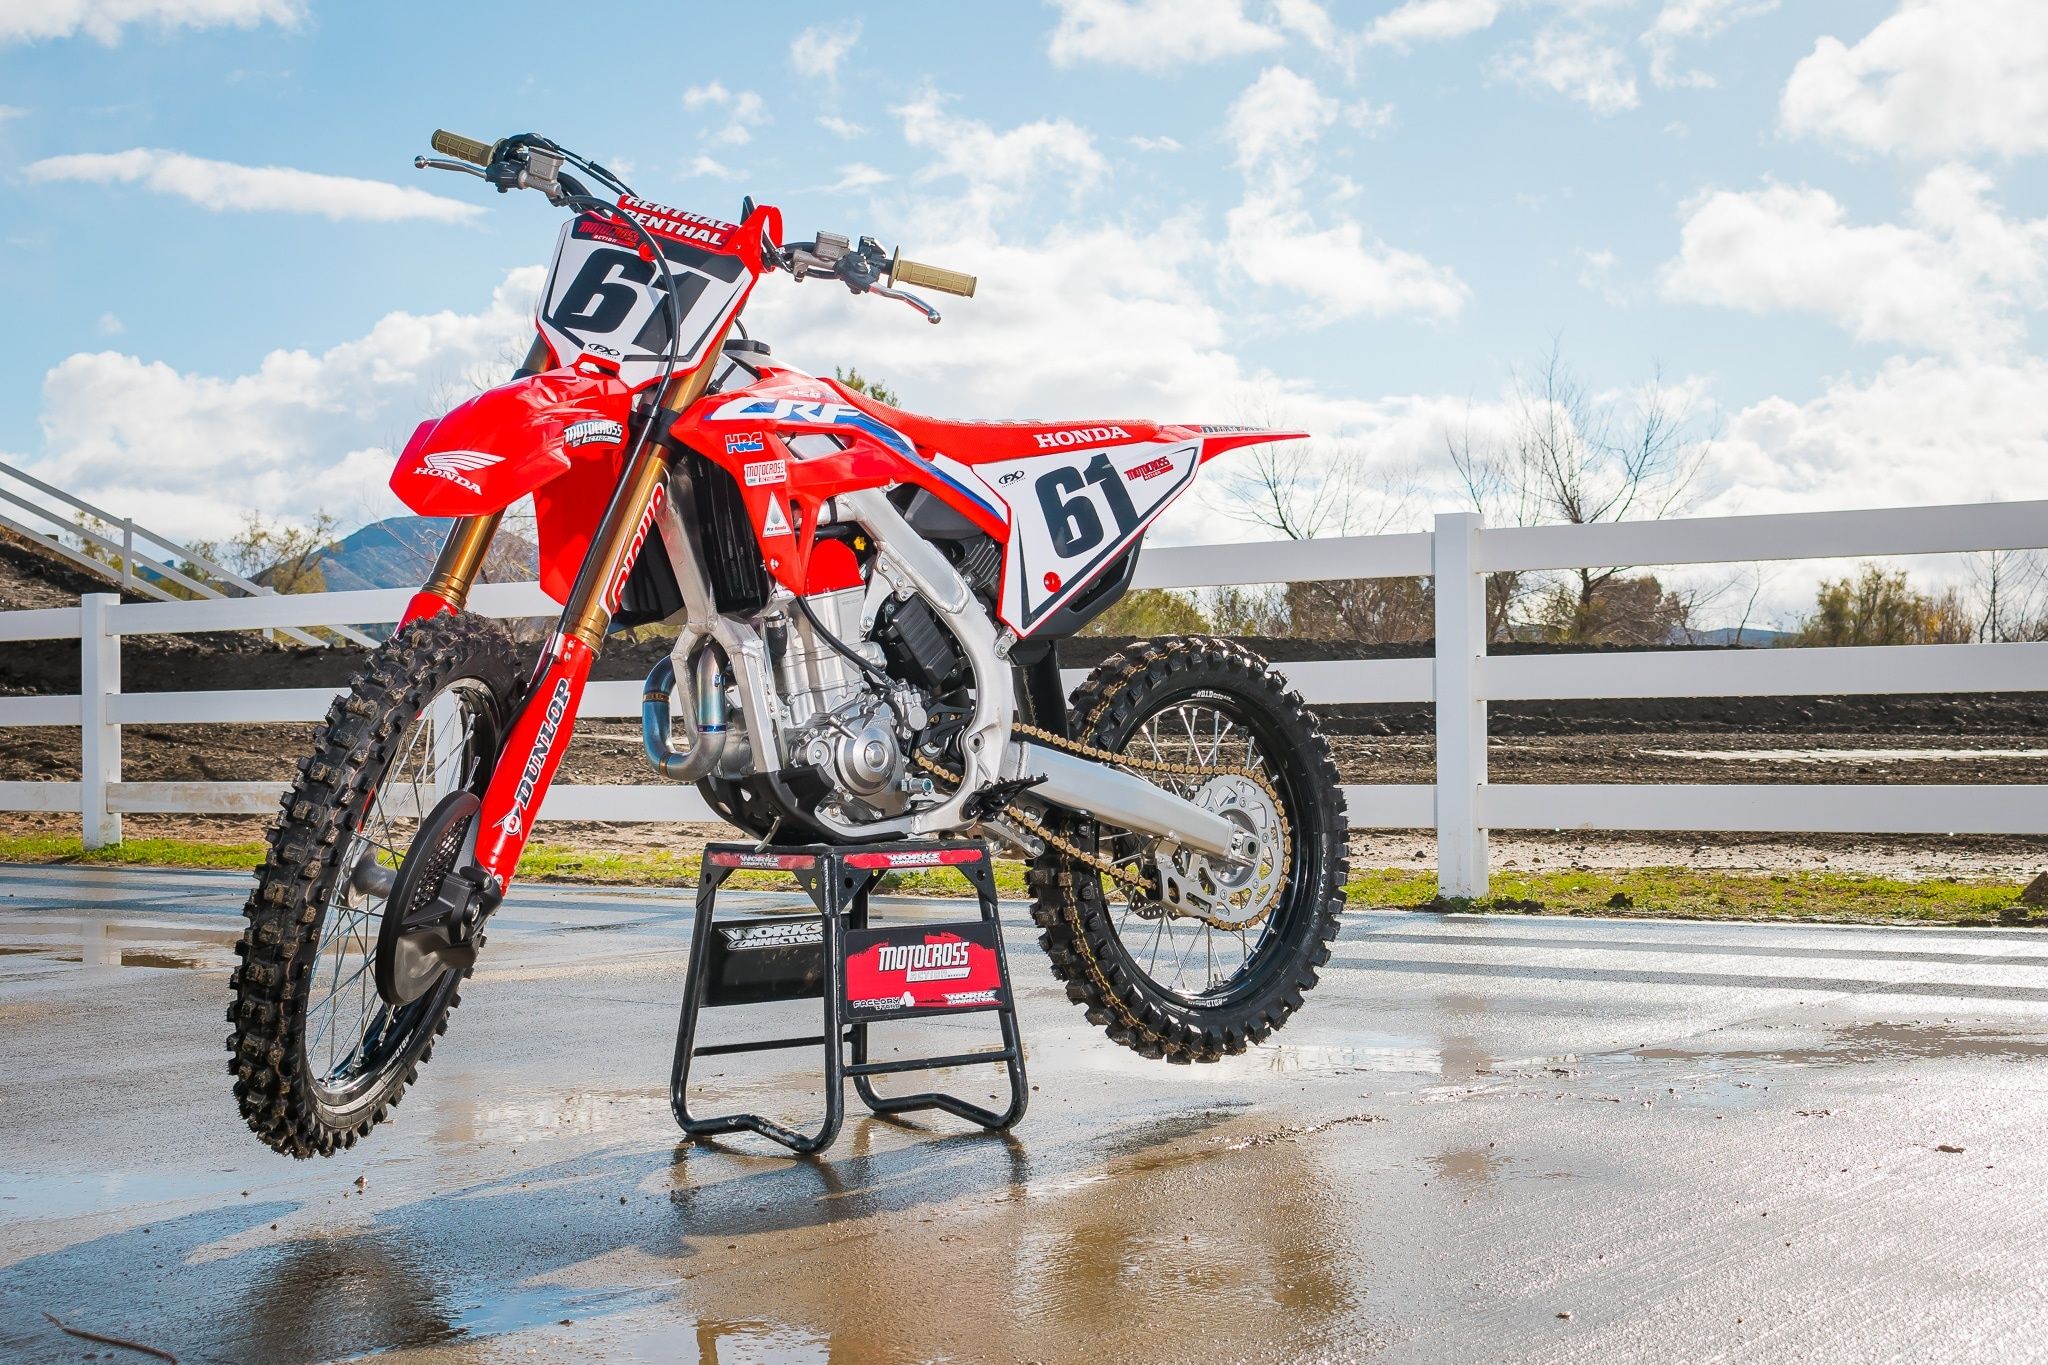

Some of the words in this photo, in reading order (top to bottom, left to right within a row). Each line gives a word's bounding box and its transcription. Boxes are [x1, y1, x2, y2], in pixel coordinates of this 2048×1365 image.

[578, 221, 640, 244] MOTOCROSS
[593, 234, 617, 243] ACTION
[622, 209, 722, 246] RENTHAL
[552, 248, 711, 356] 61
[711, 397, 860, 424] CRF
[563, 421, 623, 444] MOTOCROSS
[725, 432, 763, 454] HRC
[1033, 426, 1131, 448] HONDA
[746, 461, 785, 478] MOTOCROSS
[1124, 455, 1170, 481] MOTOCROSS
[413, 467, 482, 496] HONDA
[1035, 453, 1138, 559] 61
[514, 678, 570, 810] DUNLOP
[739, 854, 779, 863] WORKS
[888, 853, 941, 862] WORKS
[724, 923, 823, 941] WORKS
[878, 942, 970, 974] MOTOCROSS
[909, 970, 948, 981] ACTION
[853, 997, 900, 1008] FACTORY
[942, 990, 997, 1001] WORKS
